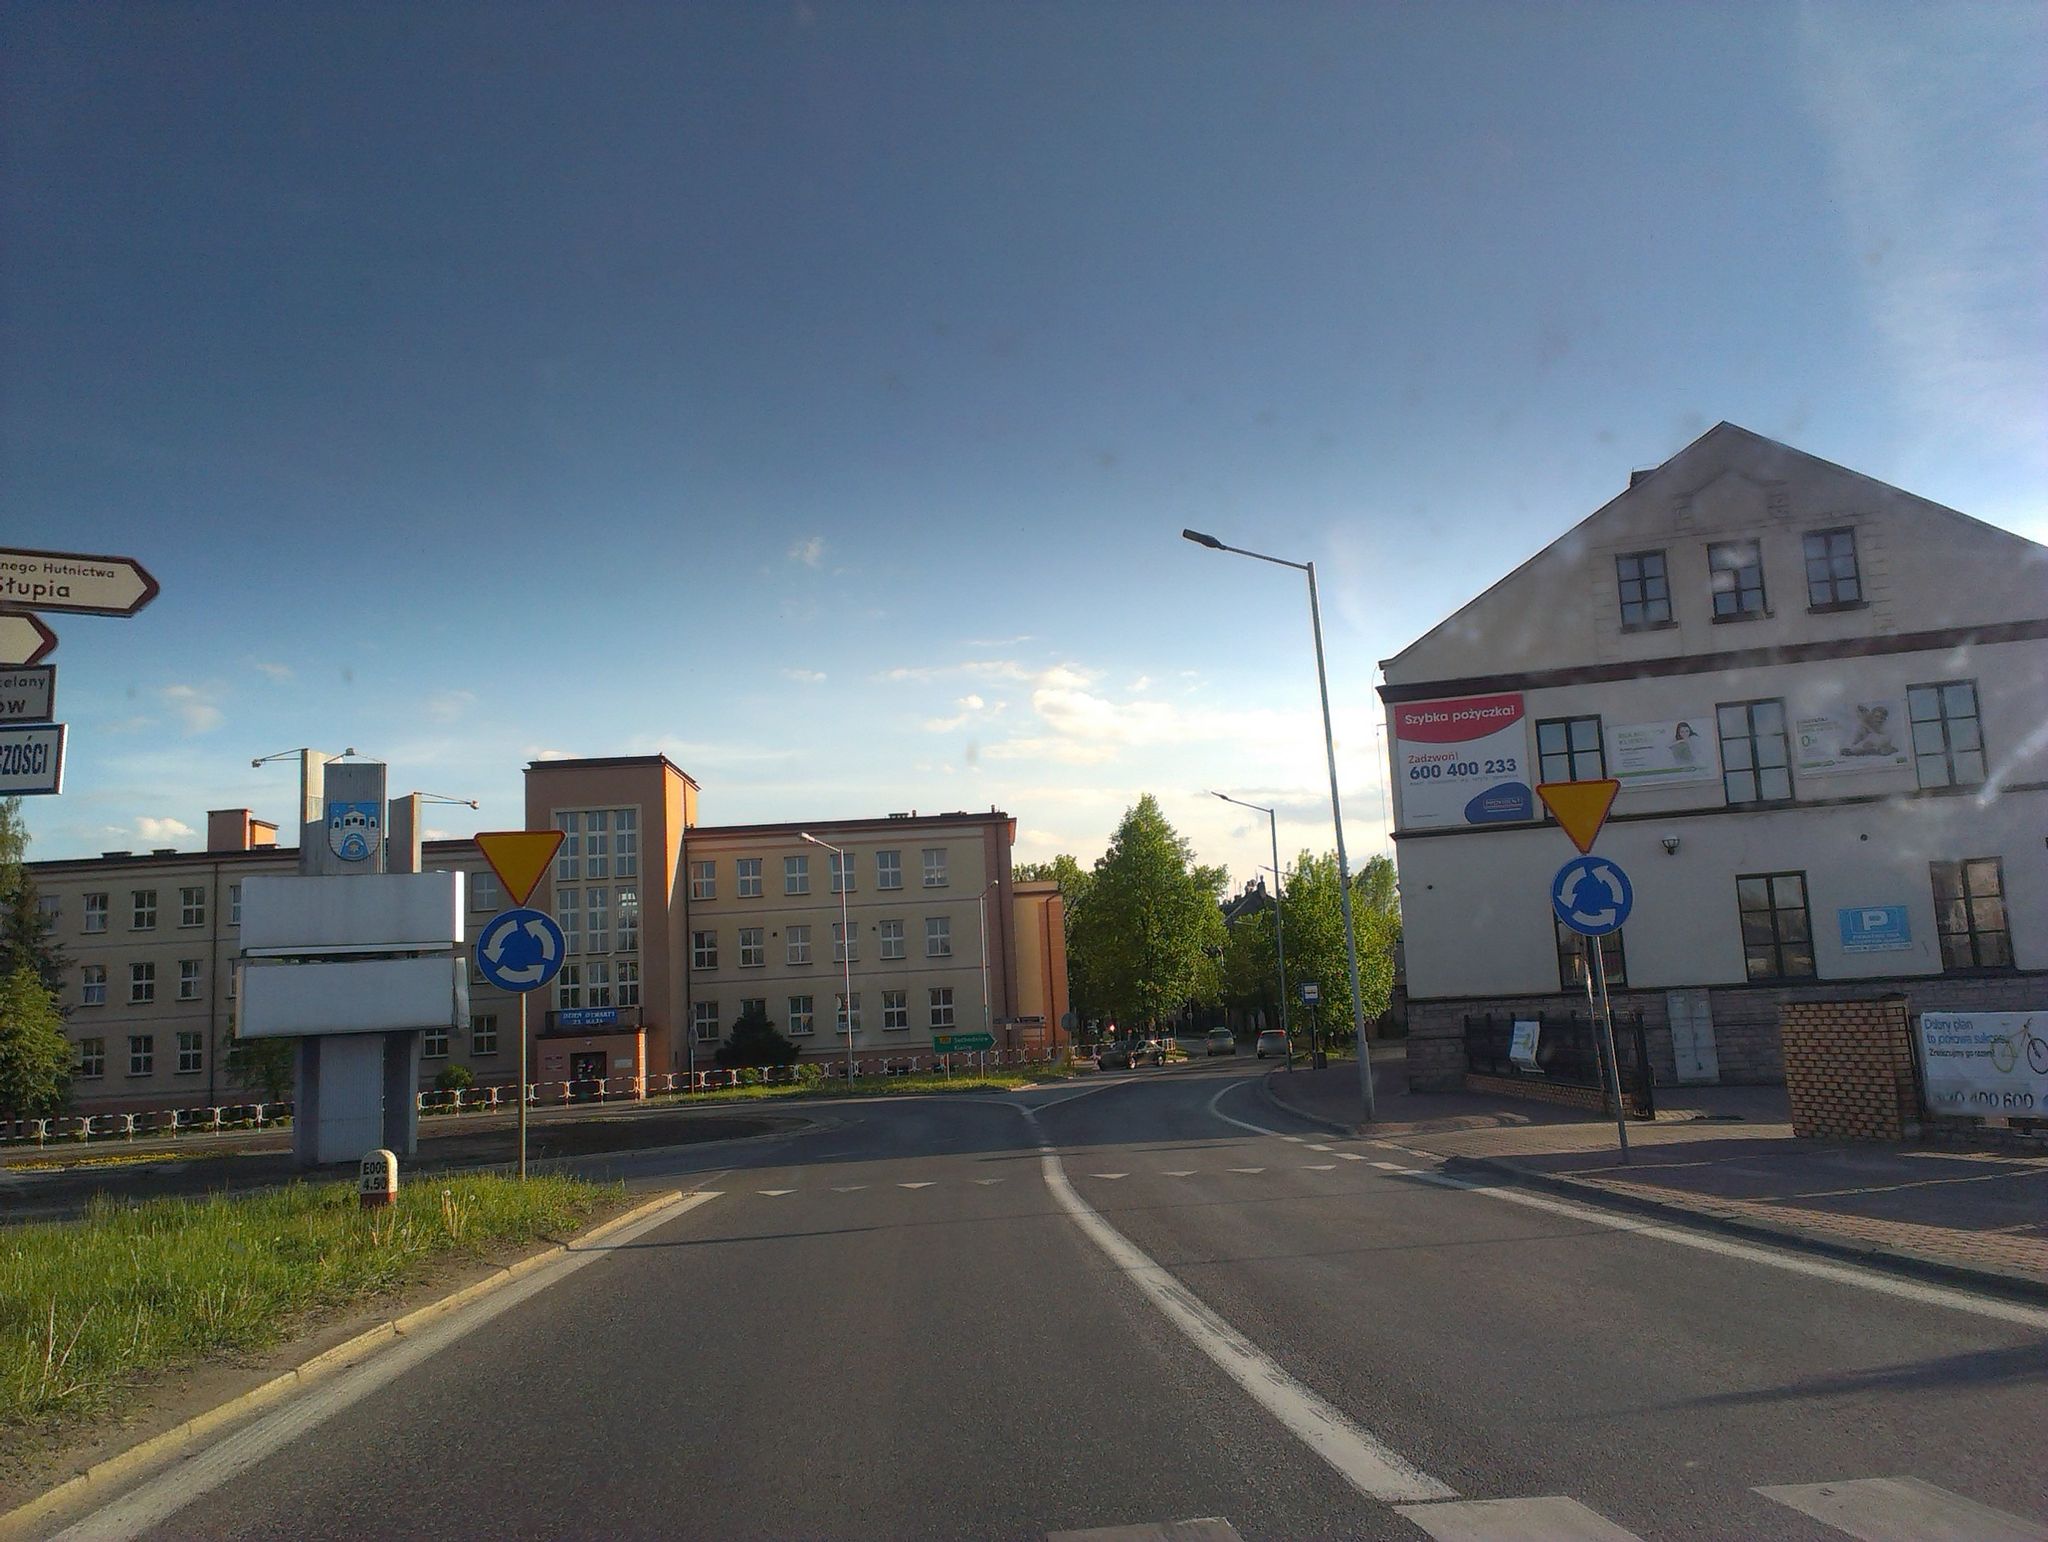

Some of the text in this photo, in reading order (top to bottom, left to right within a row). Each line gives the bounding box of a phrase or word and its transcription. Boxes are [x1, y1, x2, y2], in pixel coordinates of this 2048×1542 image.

[43, 563, 115, 578] Hutnictwa
[1405, 704, 1515, 725] Szybka pożyczka!
[1408, 751, 1459, 764] Zadzwoń!
[1409, 764, 1441, 780] 600
[1446, 761, 1479, 777] 400
[1484, 758, 1517, 774] 233
[2003, 1092, 2034, 1109] 600
